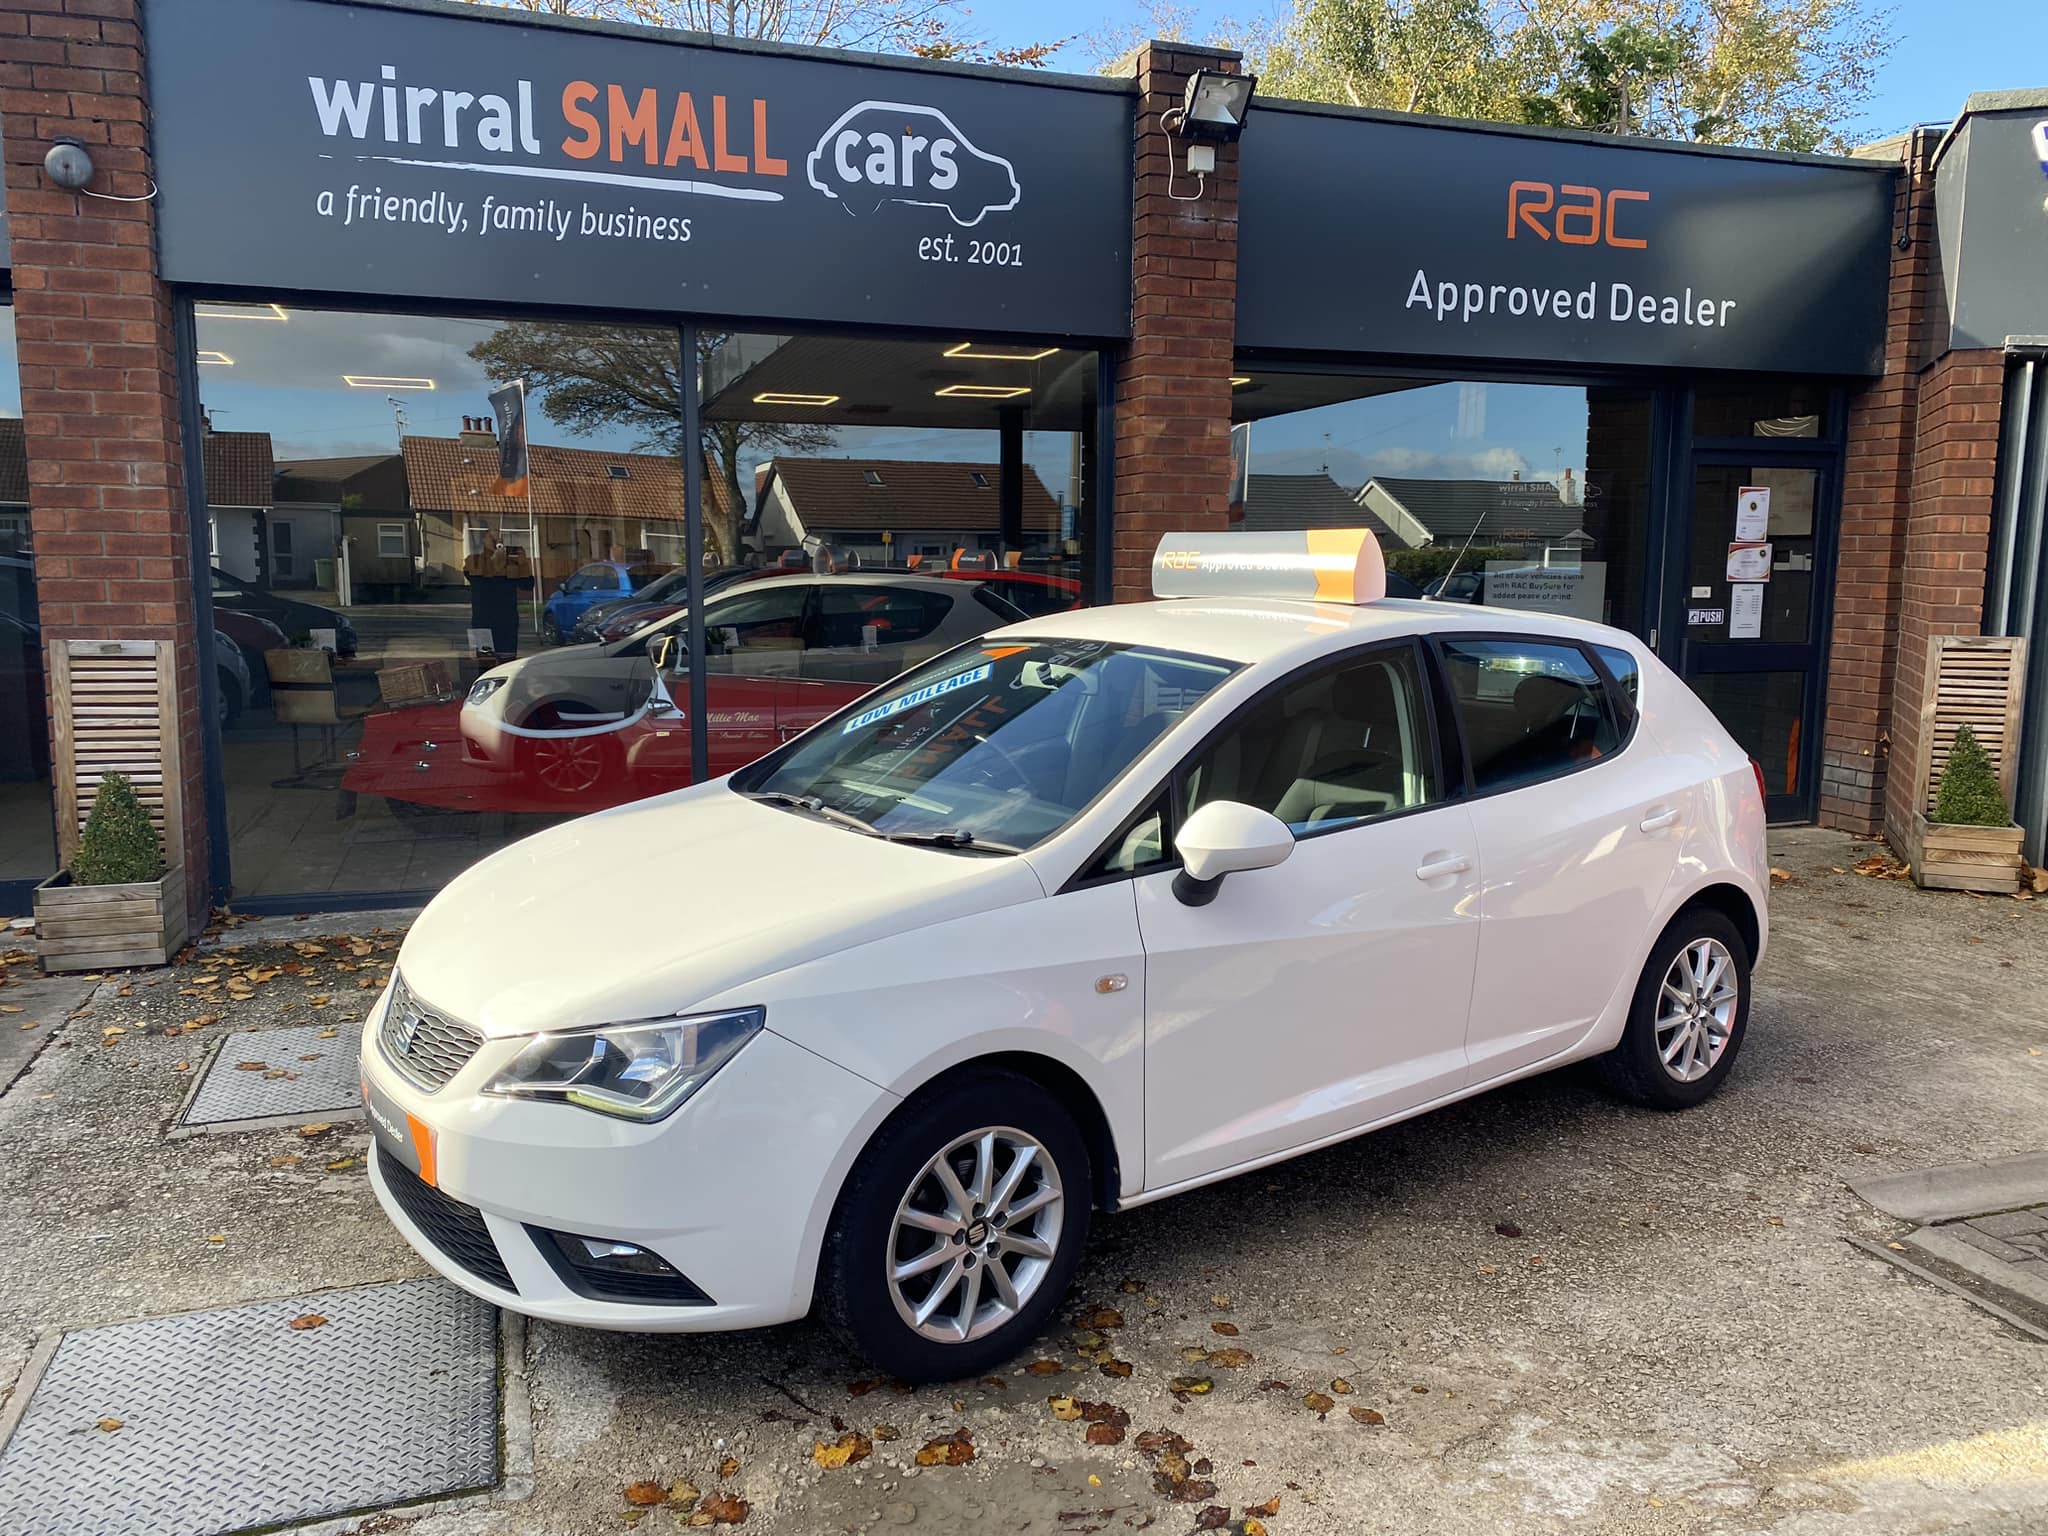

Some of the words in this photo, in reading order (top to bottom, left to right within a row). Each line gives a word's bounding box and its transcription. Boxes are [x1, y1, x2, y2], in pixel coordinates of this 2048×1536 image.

[307, 65, 541, 155] wirral
[561, 80, 788, 177] SMALL
[834, 129, 959, 190] cars
[316, 190, 334, 216] a
[344, 184, 468, 234] friendly,
[480, 196, 572, 241] family
[580, 202, 692, 242] business
[918, 233, 959, 262] est.
[967, 240, 1023, 266] 2001
[1405, 269, 1596, 323] Approved
[1609, 282, 1736, 327] Dealer
[1563, 581, 1574, 589] for
[1700, 611, 1722, 623] PUSH
[849, 702, 895, 729] LOW
[898, 668, 984, 710] MILEAGE
